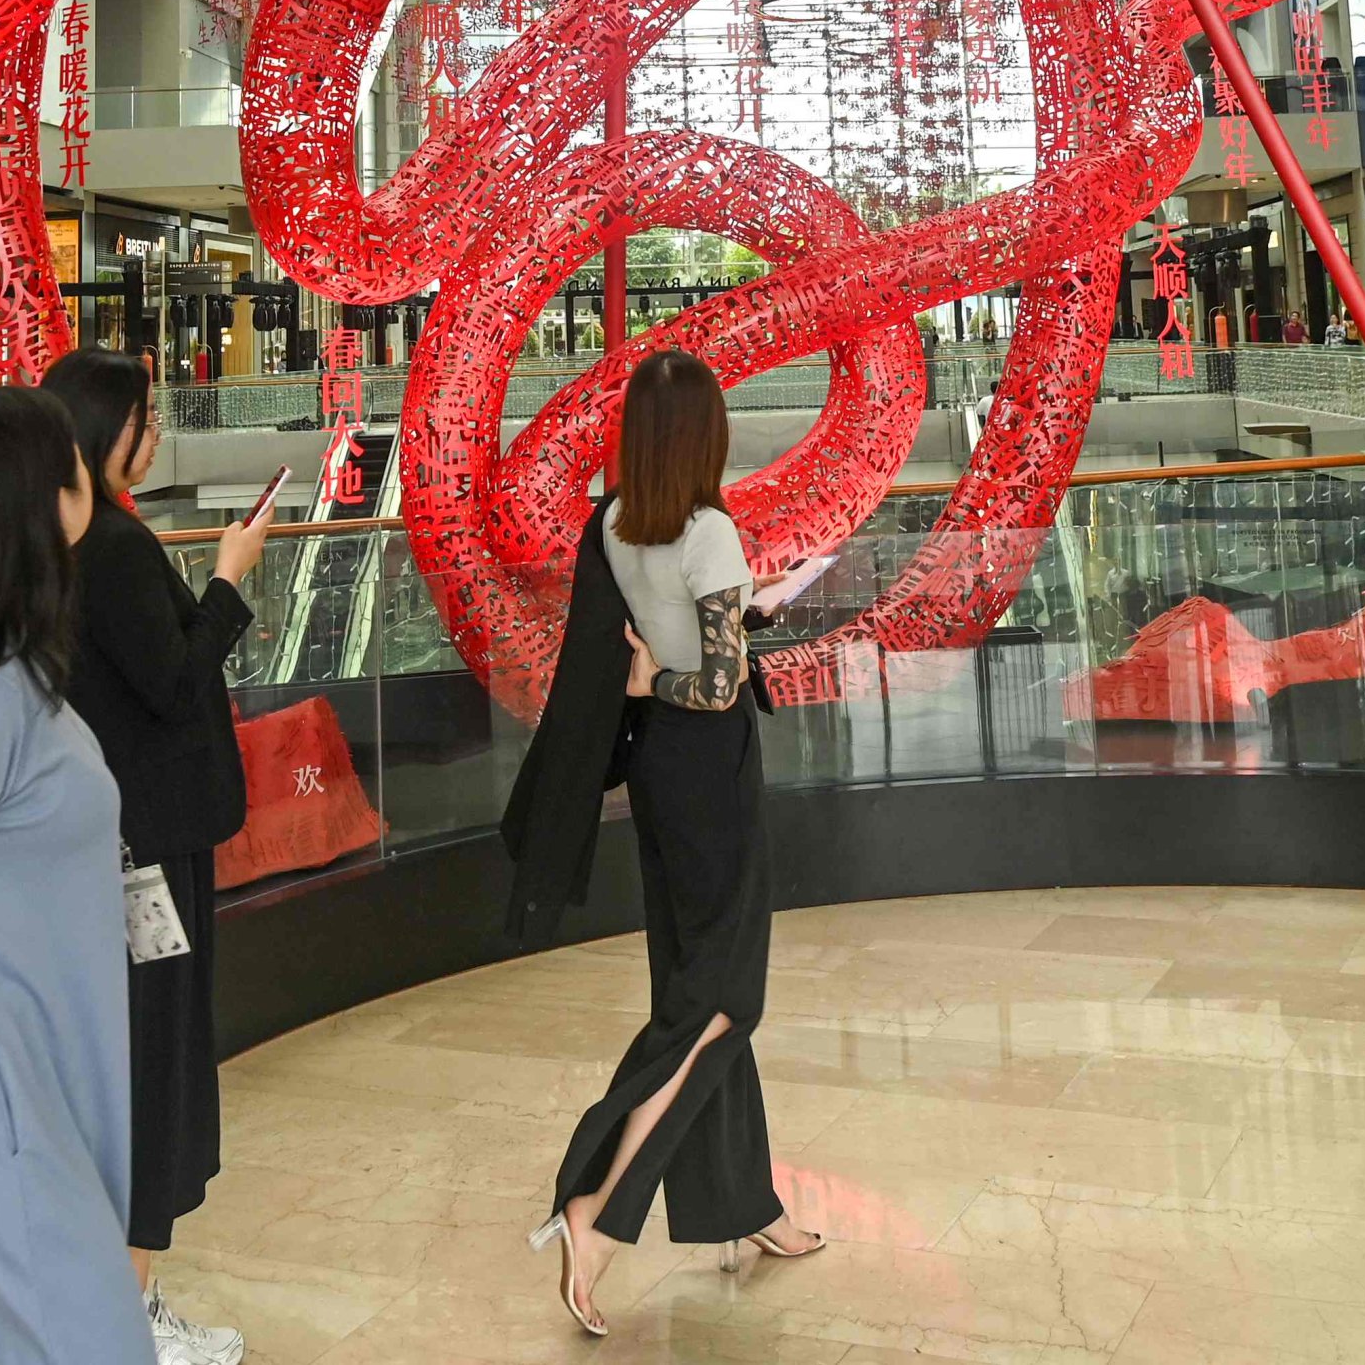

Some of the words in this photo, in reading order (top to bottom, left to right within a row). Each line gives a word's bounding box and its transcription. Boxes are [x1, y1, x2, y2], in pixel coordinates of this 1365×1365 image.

[1150, 223, 1195, 381] 天顺人和
[320, 324, 365, 505] 春回大地
[291, 764, 325, 797] 欢
